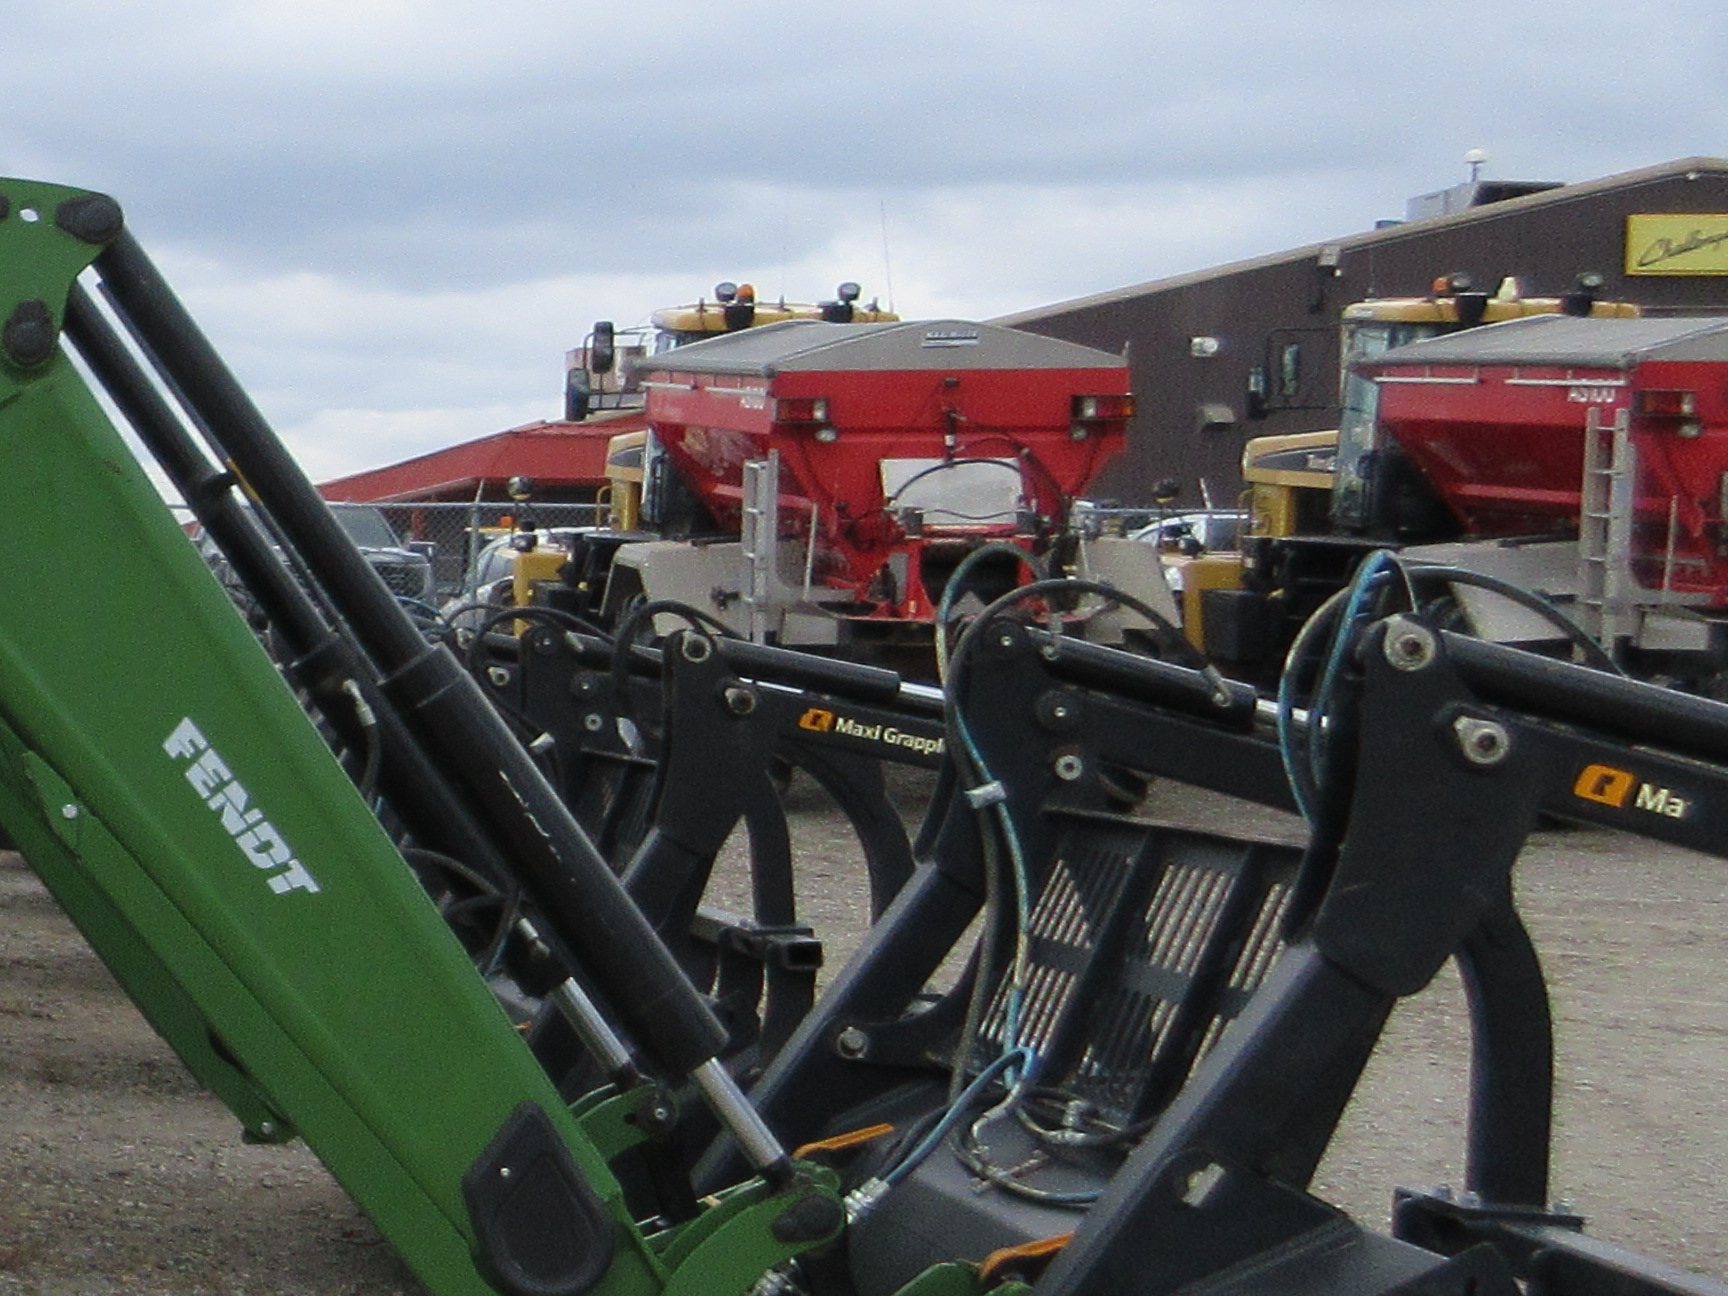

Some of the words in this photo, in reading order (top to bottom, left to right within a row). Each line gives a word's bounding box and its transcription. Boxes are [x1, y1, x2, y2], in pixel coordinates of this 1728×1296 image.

[834, 716, 882, 740] Maxi
[883, 727, 945, 755] Grappl
[163, 717, 321, 895] FENDT
[1635, 783, 1692, 818] Ma
